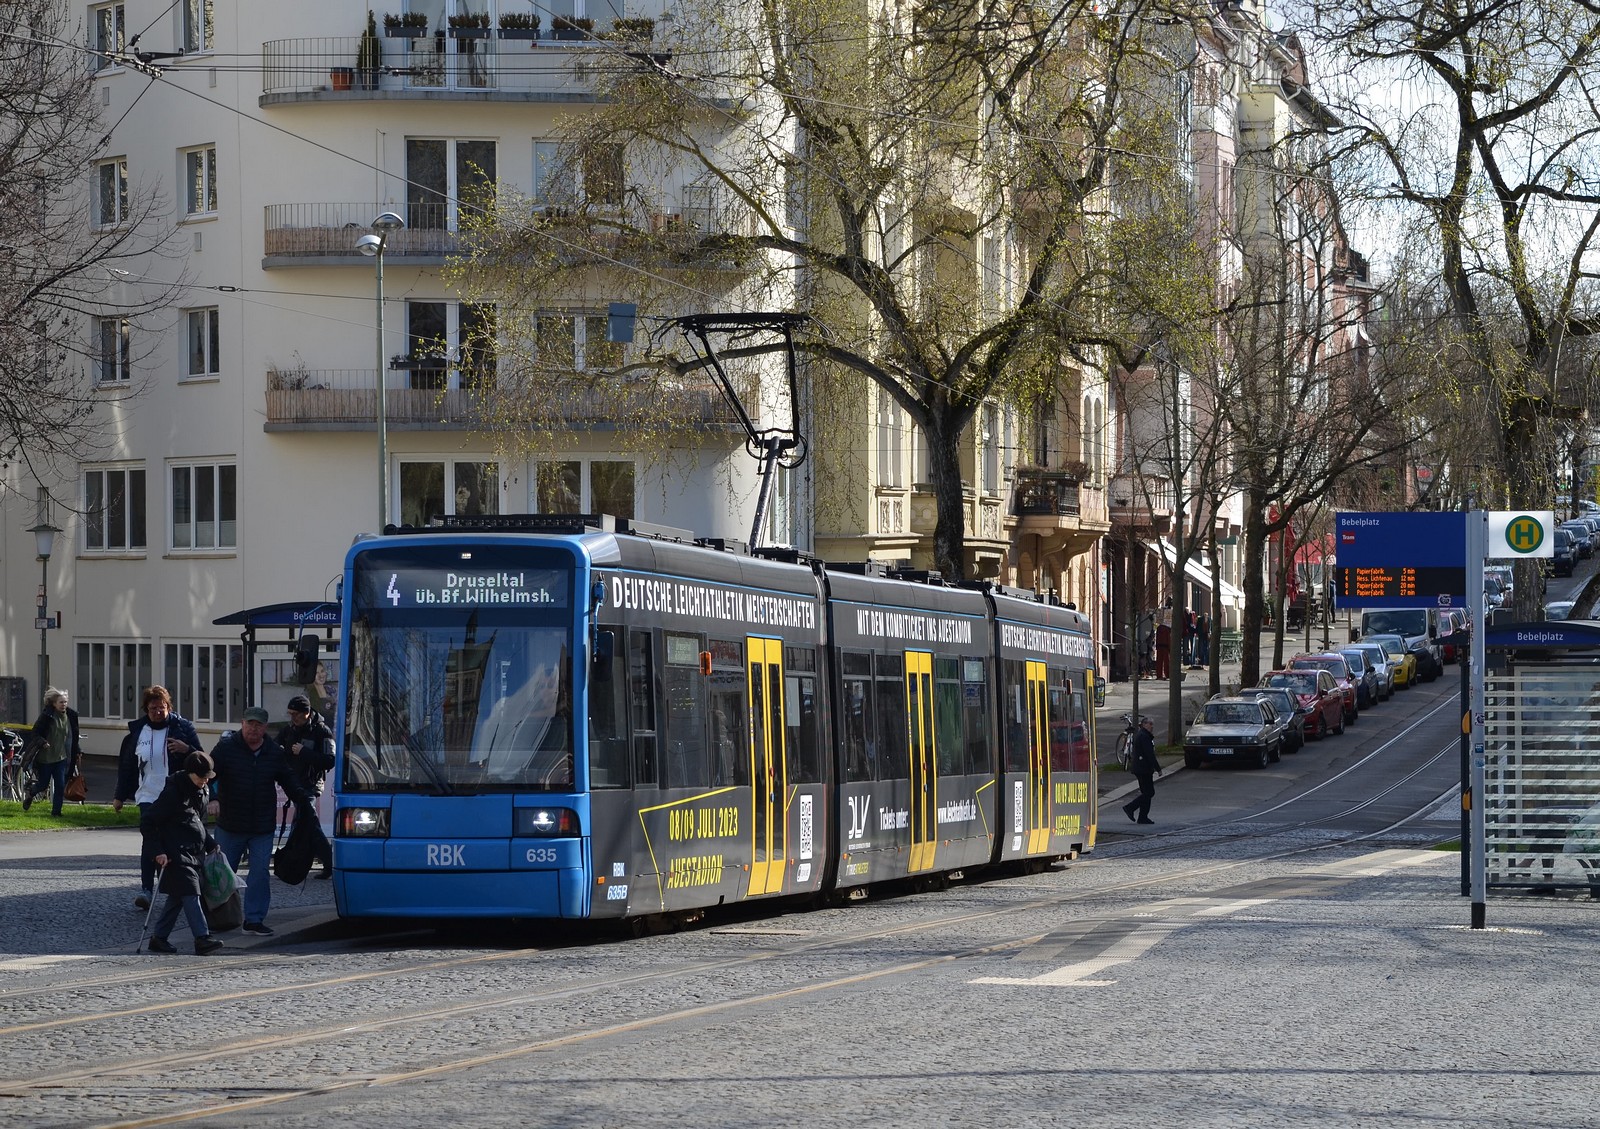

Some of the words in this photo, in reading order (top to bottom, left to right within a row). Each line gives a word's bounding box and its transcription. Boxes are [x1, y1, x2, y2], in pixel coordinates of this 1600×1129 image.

[1341, 517, 1380, 527] Bebelplatz
[1515, 523, 1534, 545] H
[447, 572, 525, 587] Druseltal
[1356, 567, 1385, 576] Papierfabrik
[1402, 567, 1407, 575] 5
[1407, 567, 1416, 575] min
[386, 573, 401, 606] 4
[1356, 581, 1385, 590] Papierfabrik
[1356, 589, 1385, 597] Papierfabrik
[612, 576, 673, 613] DEUTSCHE
[674, 584, 745, 622] LEICHTATHLETIK
[746, 594, 816, 630] MEISTERSCHAFTEN
[857, 609, 870, 636] MIT
[870, 610, 885, 637] DEM
[886, 612, 926, 641] KOMBITICKET
[926, 617, 937, 642] INS
[938, 618, 972, 644] AUESTADION
[1517, 631, 1564, 643] Bebelplatz
[1002, 624, 1026, 649] DEUTSCHE
[1026, 628, 1062, 654] LEICHTATHLETIK
[669, 808, 695, 843] 08/09
[697, 807, 716, 839] JULI
[718, 806, 738, 837] 2023
[848, 794, 871, 840] DLV
[879, 806, 896, 831] Tickets
[426, 844, 466, 866] RBK
[526, 848, 557, 863] 635
[612, 862, 625, 877] RBK
[667, 854, 723, 889] AUESTADION
[606, 884, 628, 901] 635B
